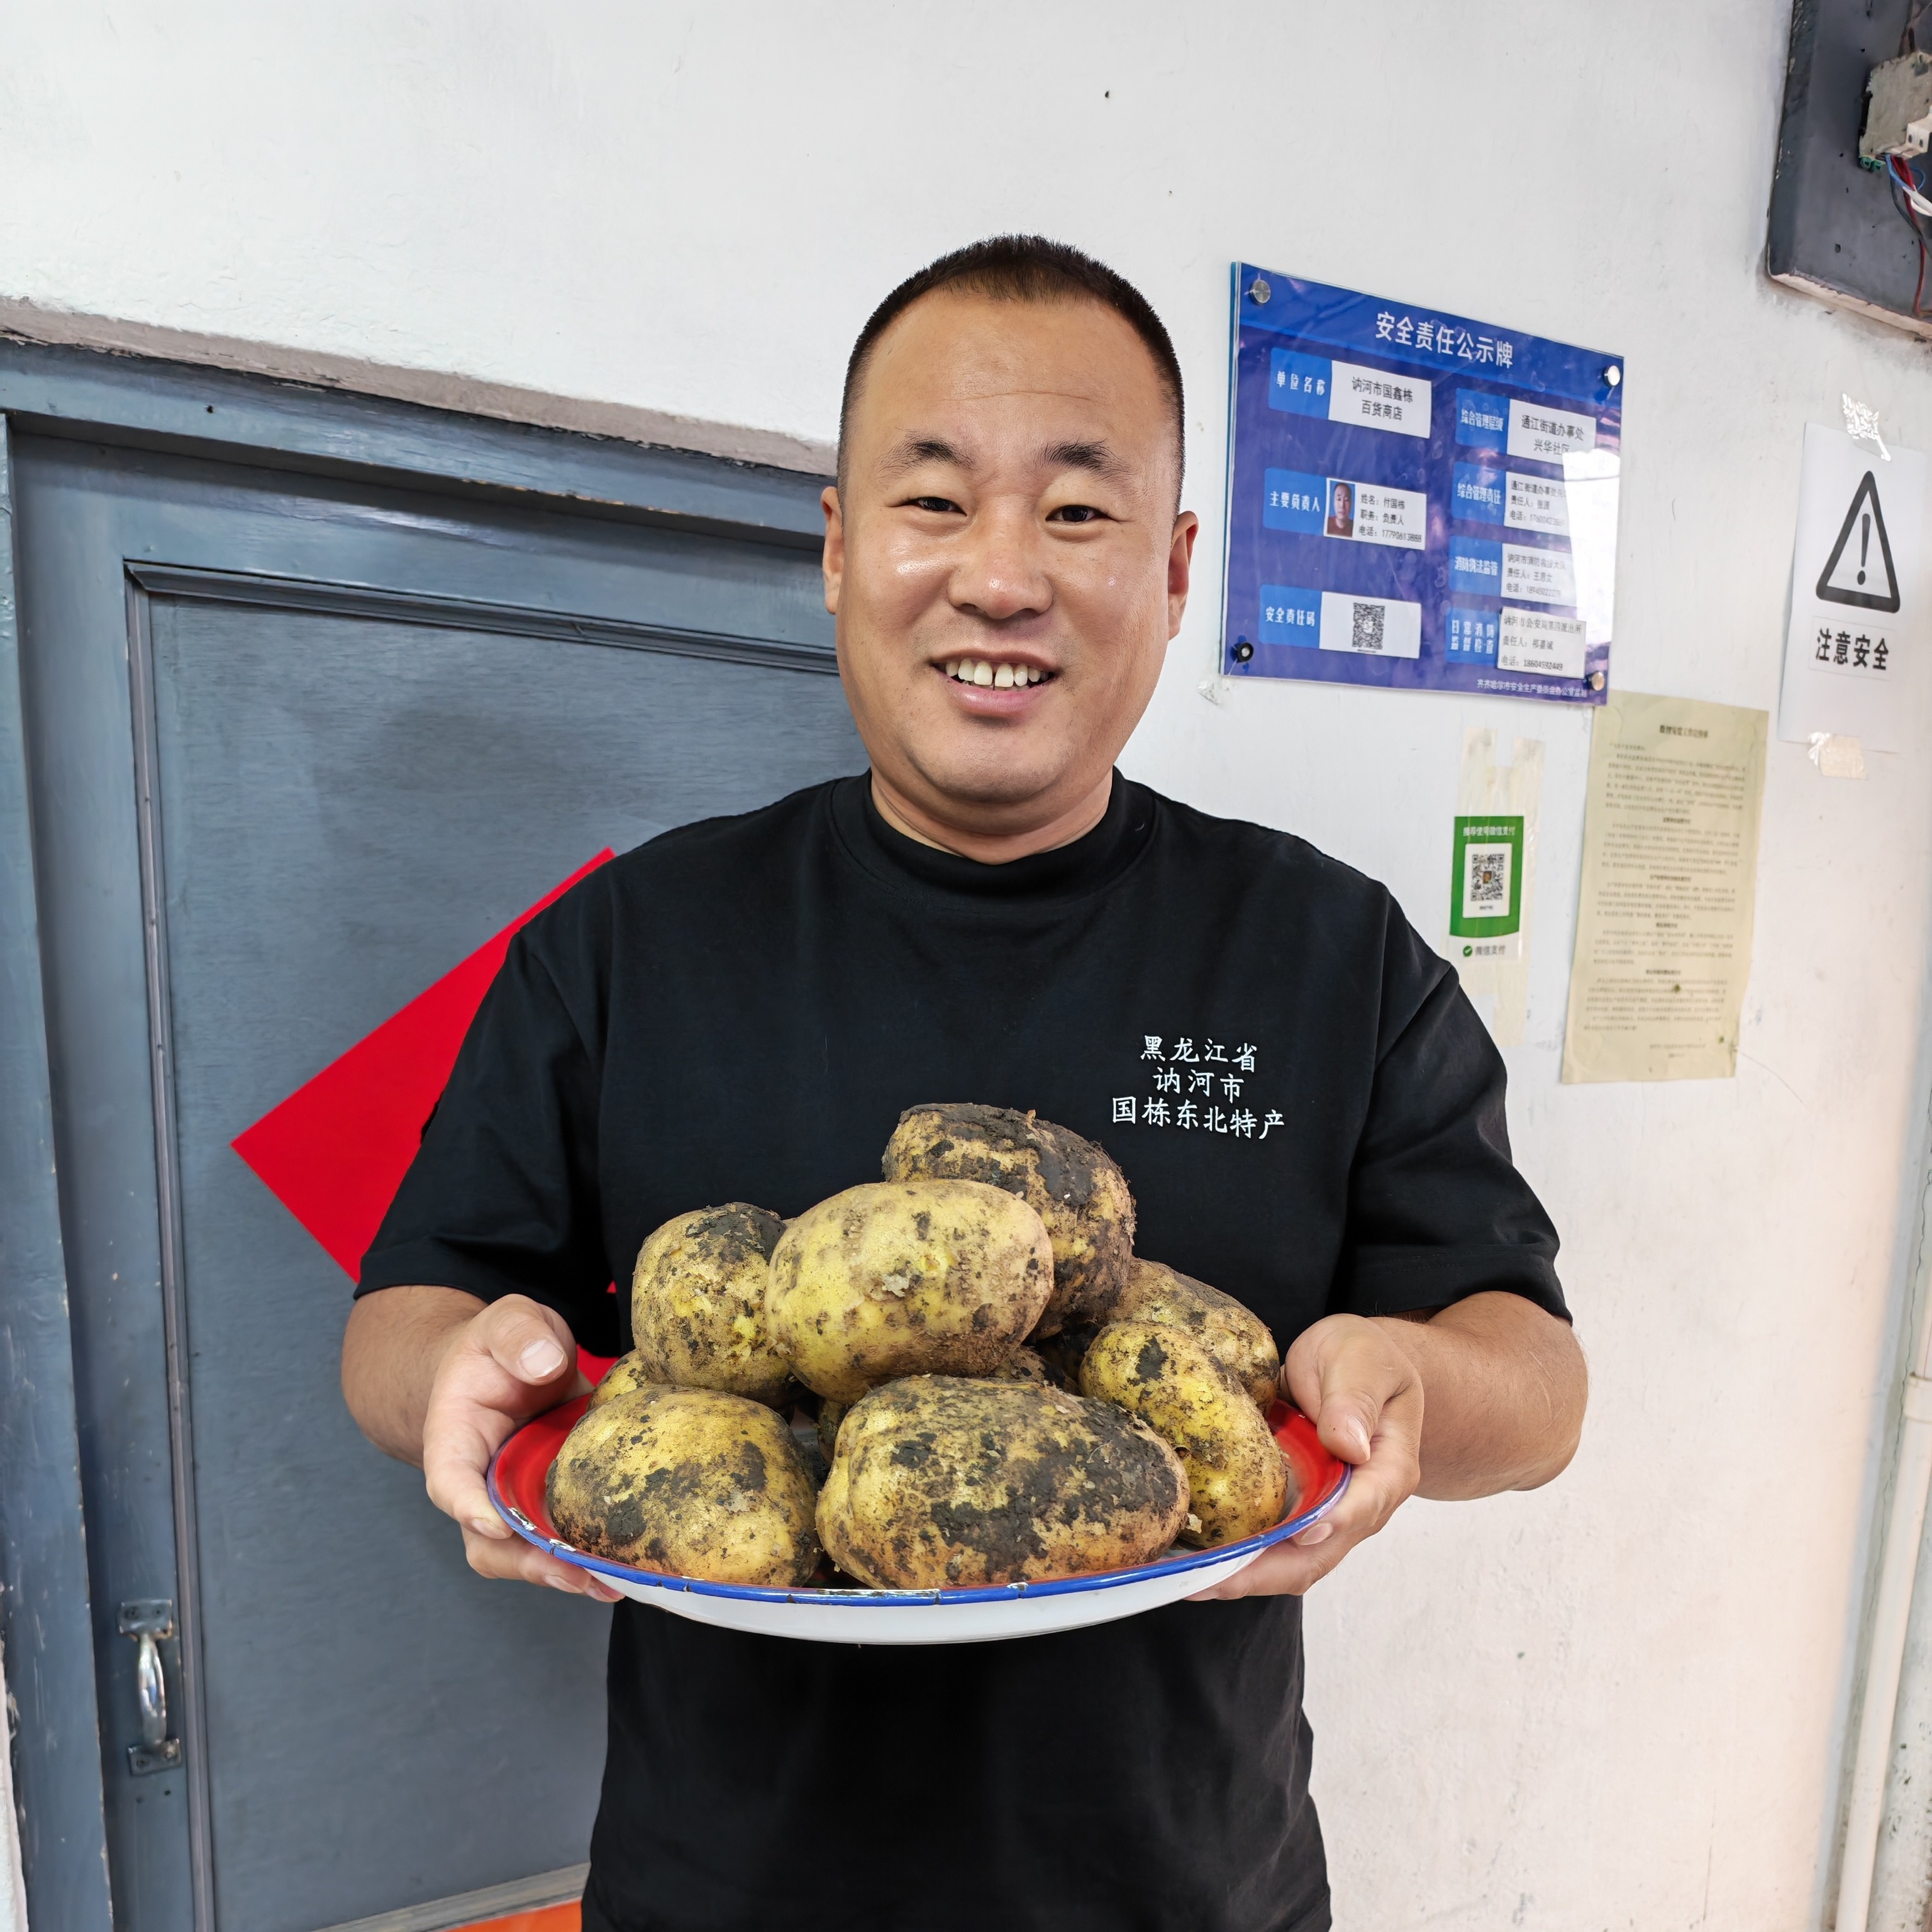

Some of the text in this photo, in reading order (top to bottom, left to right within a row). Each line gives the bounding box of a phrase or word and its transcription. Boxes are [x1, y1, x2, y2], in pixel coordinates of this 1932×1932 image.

[1375, 311, 1514, 370] 安全责任公示牌
[1276, 371, 1326, 396] 单位名称
[1361, 399, 1403, 421] 百货商店
[1521, 414, 1584, 441] 通江街道办事处
[1270, 491, 1321, 513] 主要负责人
[1265, 606, 1316, 627] 安全责任码
[1816, 628, 1889, 670] 注意安全
[1475, 945, 1506, 956] 微信支付
[1140, 1035, 1257, 1072] 黑龙江省
[1152, 1067, 1244, 1104] 讷河市
[1112, 1096, 1285, 1140] 国栋东北特产
